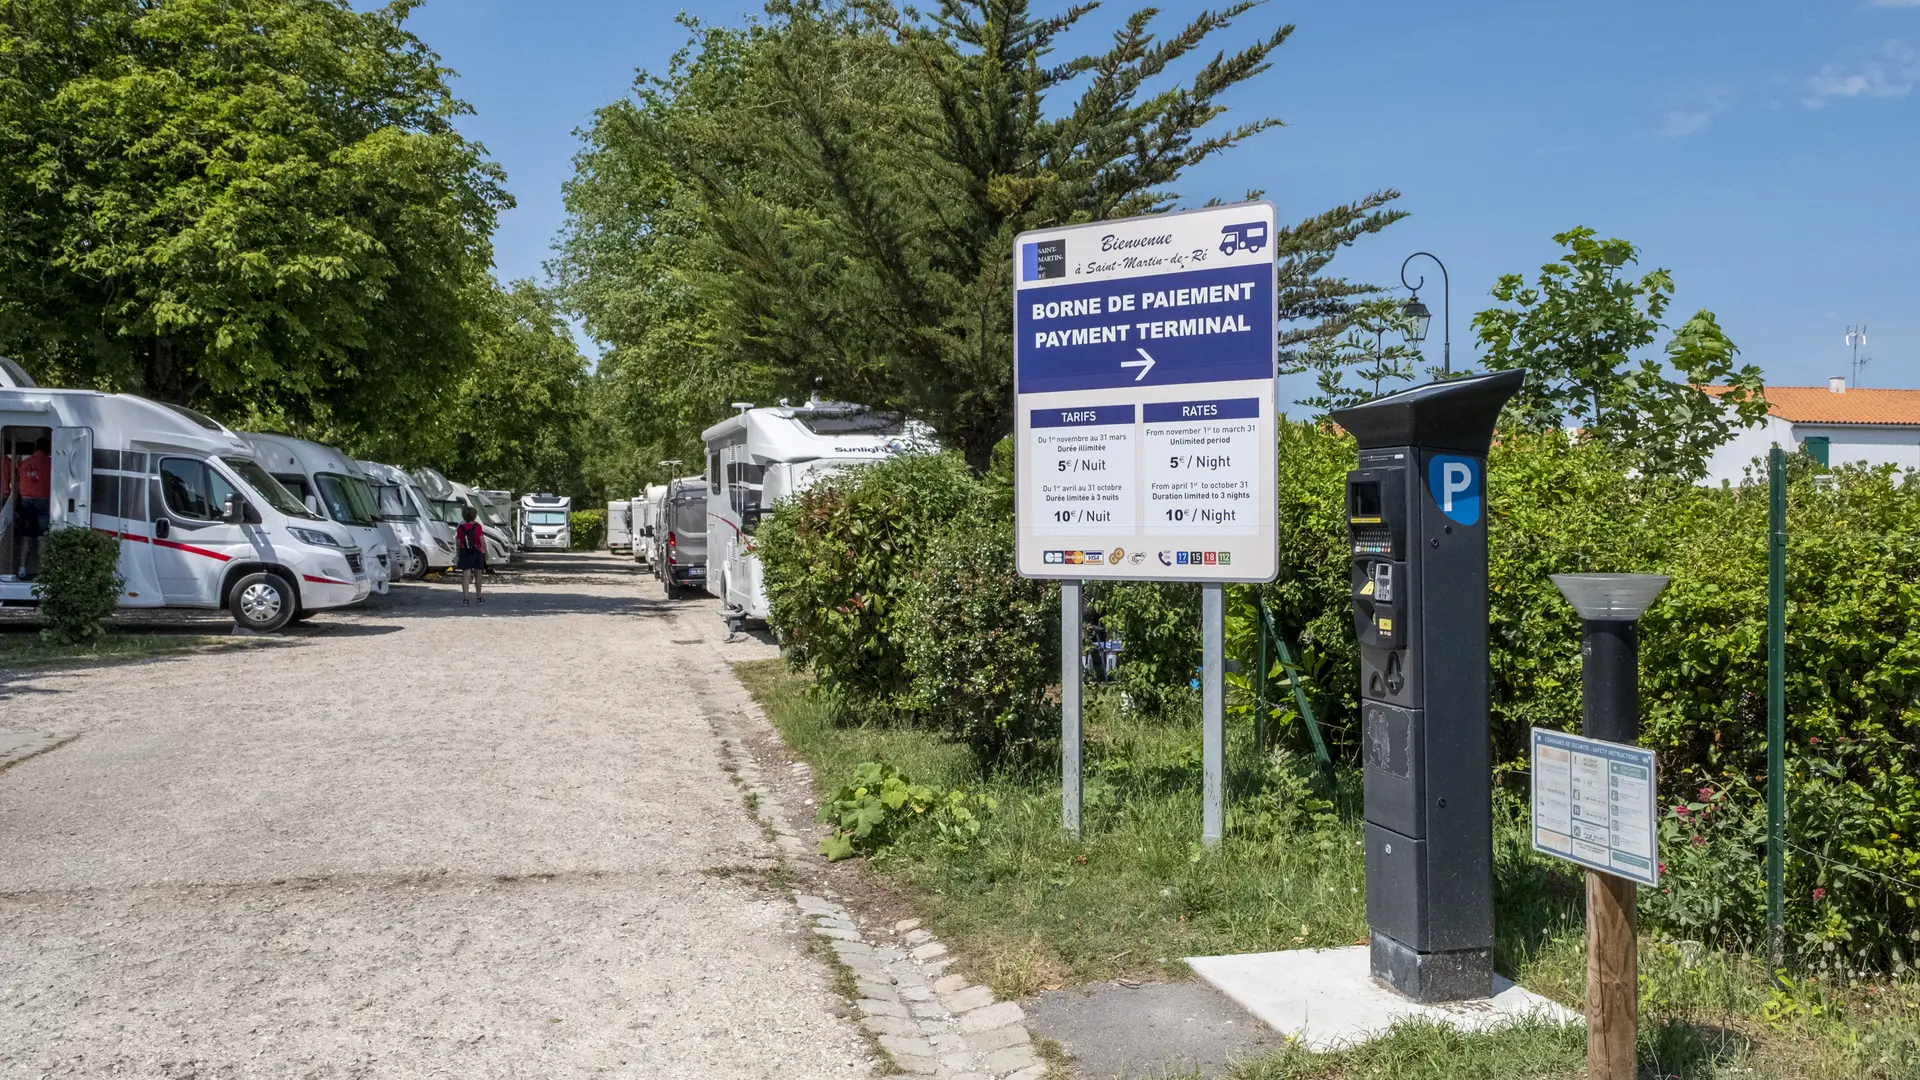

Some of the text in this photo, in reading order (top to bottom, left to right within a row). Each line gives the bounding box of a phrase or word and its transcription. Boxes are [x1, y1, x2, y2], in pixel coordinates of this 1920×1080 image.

[1101, 234, 1173, 252] Bienvenue
[1075, 263, 1082, 275] à
[1032, 282, 1255, 320] BORNE DE PAIEMENT
[1035, 314, 1251, 348] PAYMENT TERMINAL
[1182, 404, 1218, 417] RATES
[1061, 411, 1096, 422] TARIFS
[1166, 427, 1201, 436] november
[1222, 425, 1246, 433] march
[1247, 424, 1256, 432] 31
[1056, 435, 1089, 443] novembre
[1109, 433, 1127, 441] mars
[1170, 436, 1231, 446] Unlimited period
[1079, 444, 1106, 452] illimitée
[1082, 459, 1106, 471] Nuit
[1196, 455, 1231, 471] Night
[1062, 484, 1077, 492] avril
[1096, 484, 1123, 492] octobre
[1151, 482, 1170, 490] From
[1171, 482, 1188, 491] april
[1210, 480, 1238, 489] october
[1443, 462, 1472, 512] P
[1046, 494, 1065, 502] Durée
[1066, 494, 1090, 502] limitée
[1090, 493, 1095, 501] à
[1102, 493, 1119, 501] nuits
[1152, 492, 1183, 500] Duration
[1184, 491, 1210, 499] limited
[1226, 491, 1250, 500] nights
[1086, 510, 1110, 522] Nuit
[1201, 508, 1236, 524] Night
[1178, 552, 1187, 560] 17
[1191, 552, 1201, 560] 15
[1205, 552, 1215, 560] 18
[1219, 552, 1230, 560] 112
